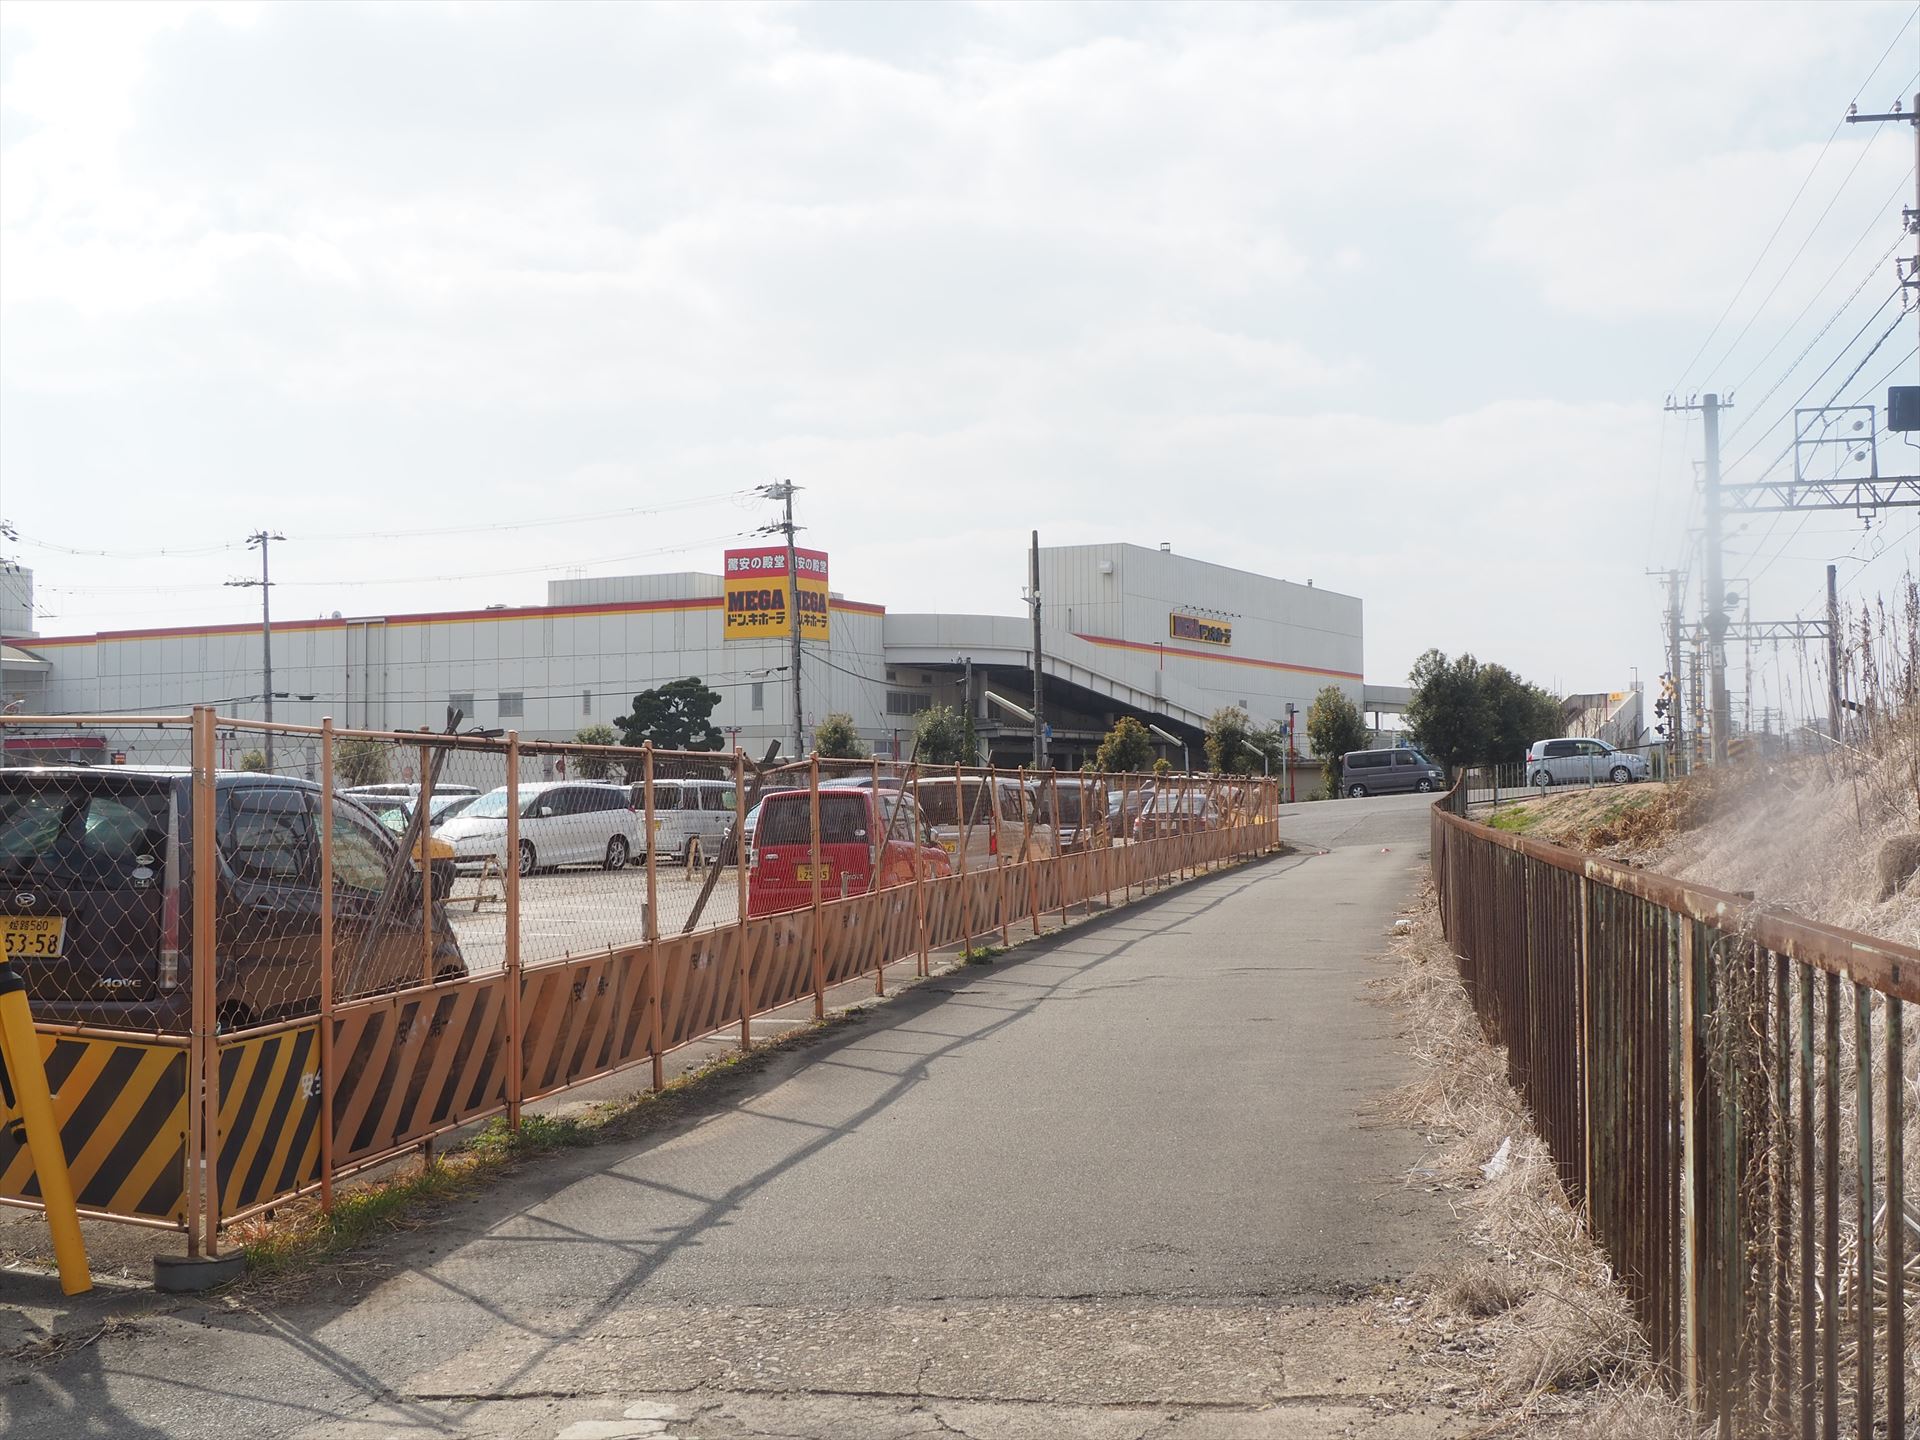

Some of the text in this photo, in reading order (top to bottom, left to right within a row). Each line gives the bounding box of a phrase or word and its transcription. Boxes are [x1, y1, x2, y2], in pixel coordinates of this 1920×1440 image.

[795, 556, 827, 573] 安の殿堂
[728, 589, 785, 612] MEGA
[5, 933, 58, 954] 53-58
